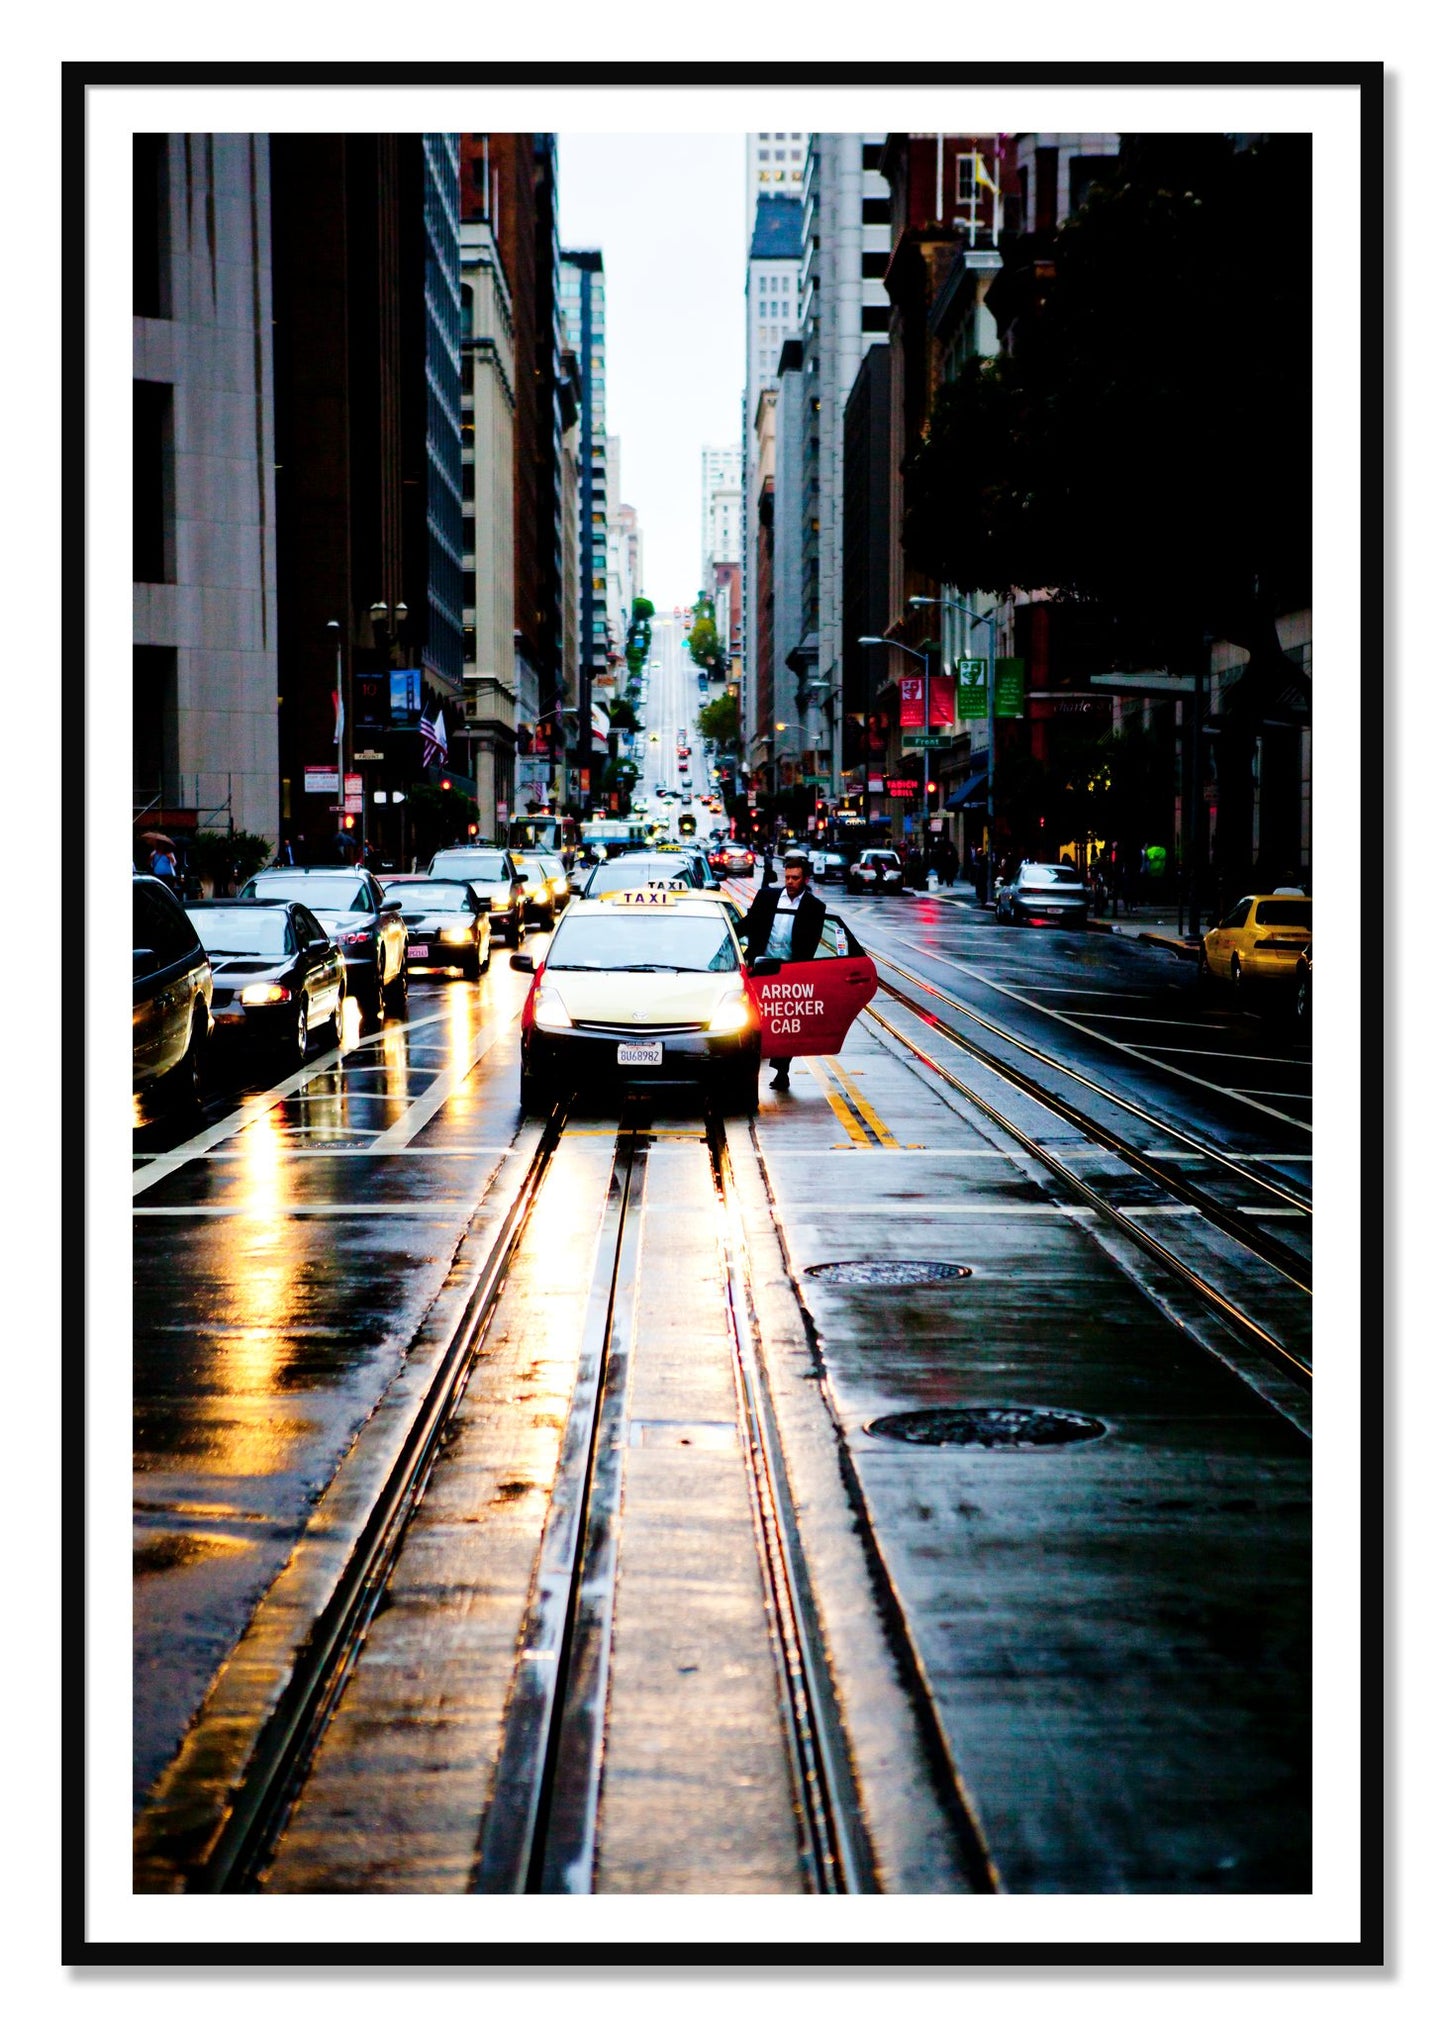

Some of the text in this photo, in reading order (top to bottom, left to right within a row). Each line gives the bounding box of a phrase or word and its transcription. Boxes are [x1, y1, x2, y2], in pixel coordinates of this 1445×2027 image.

[1053, 699, 1096, 713] charle
[914, 737, 940, 746] Front
[887, 779, 919, 789] TADICH
[890, 789, 915, 798] GRILL
[648, 882, 683, 890] TAXI
[624, 893, 667, 904] TAXI
[761, 984, 814, 999] ARROW
[771, 1019, 801, 1034] CAB
